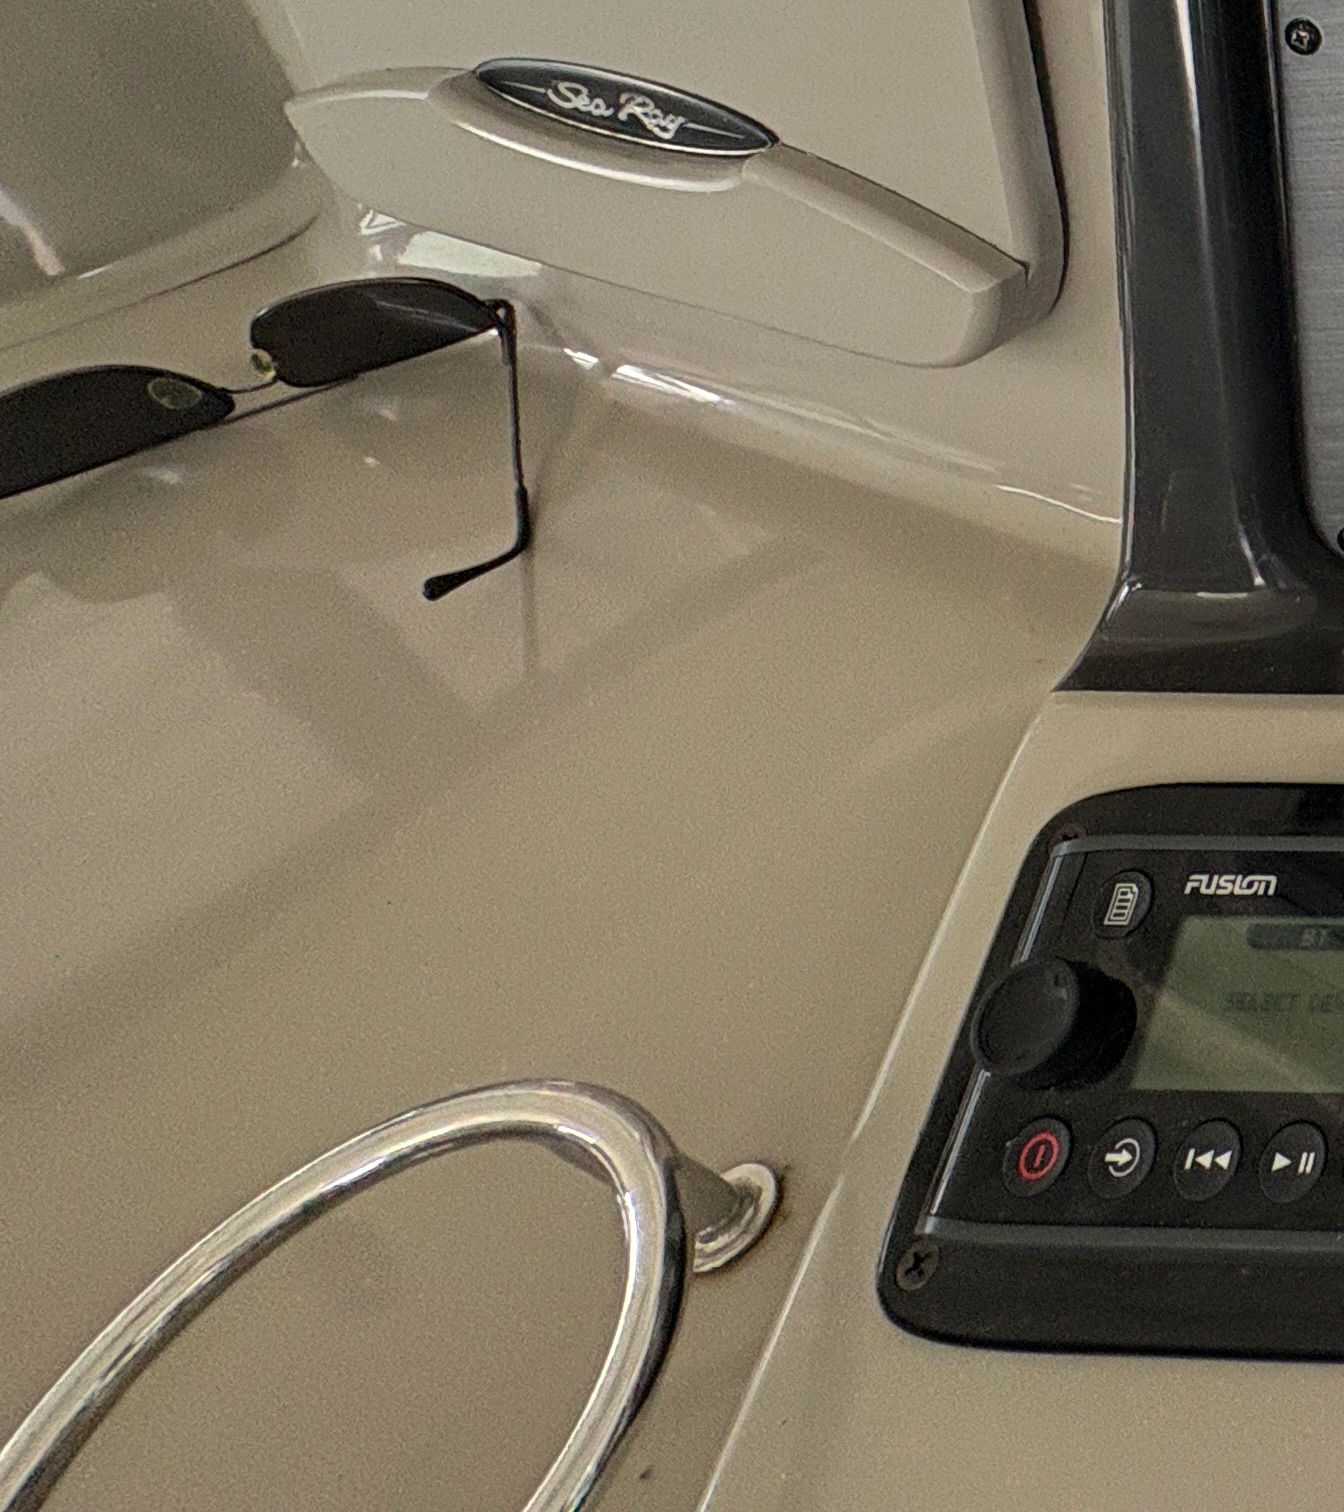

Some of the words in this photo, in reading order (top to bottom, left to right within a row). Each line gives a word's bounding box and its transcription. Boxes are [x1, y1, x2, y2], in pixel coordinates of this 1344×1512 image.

[545, 80, 615, 118] Sea
[618, 90, 687, 141] Ray
[1183, 873, 1278, 897] FUSION
